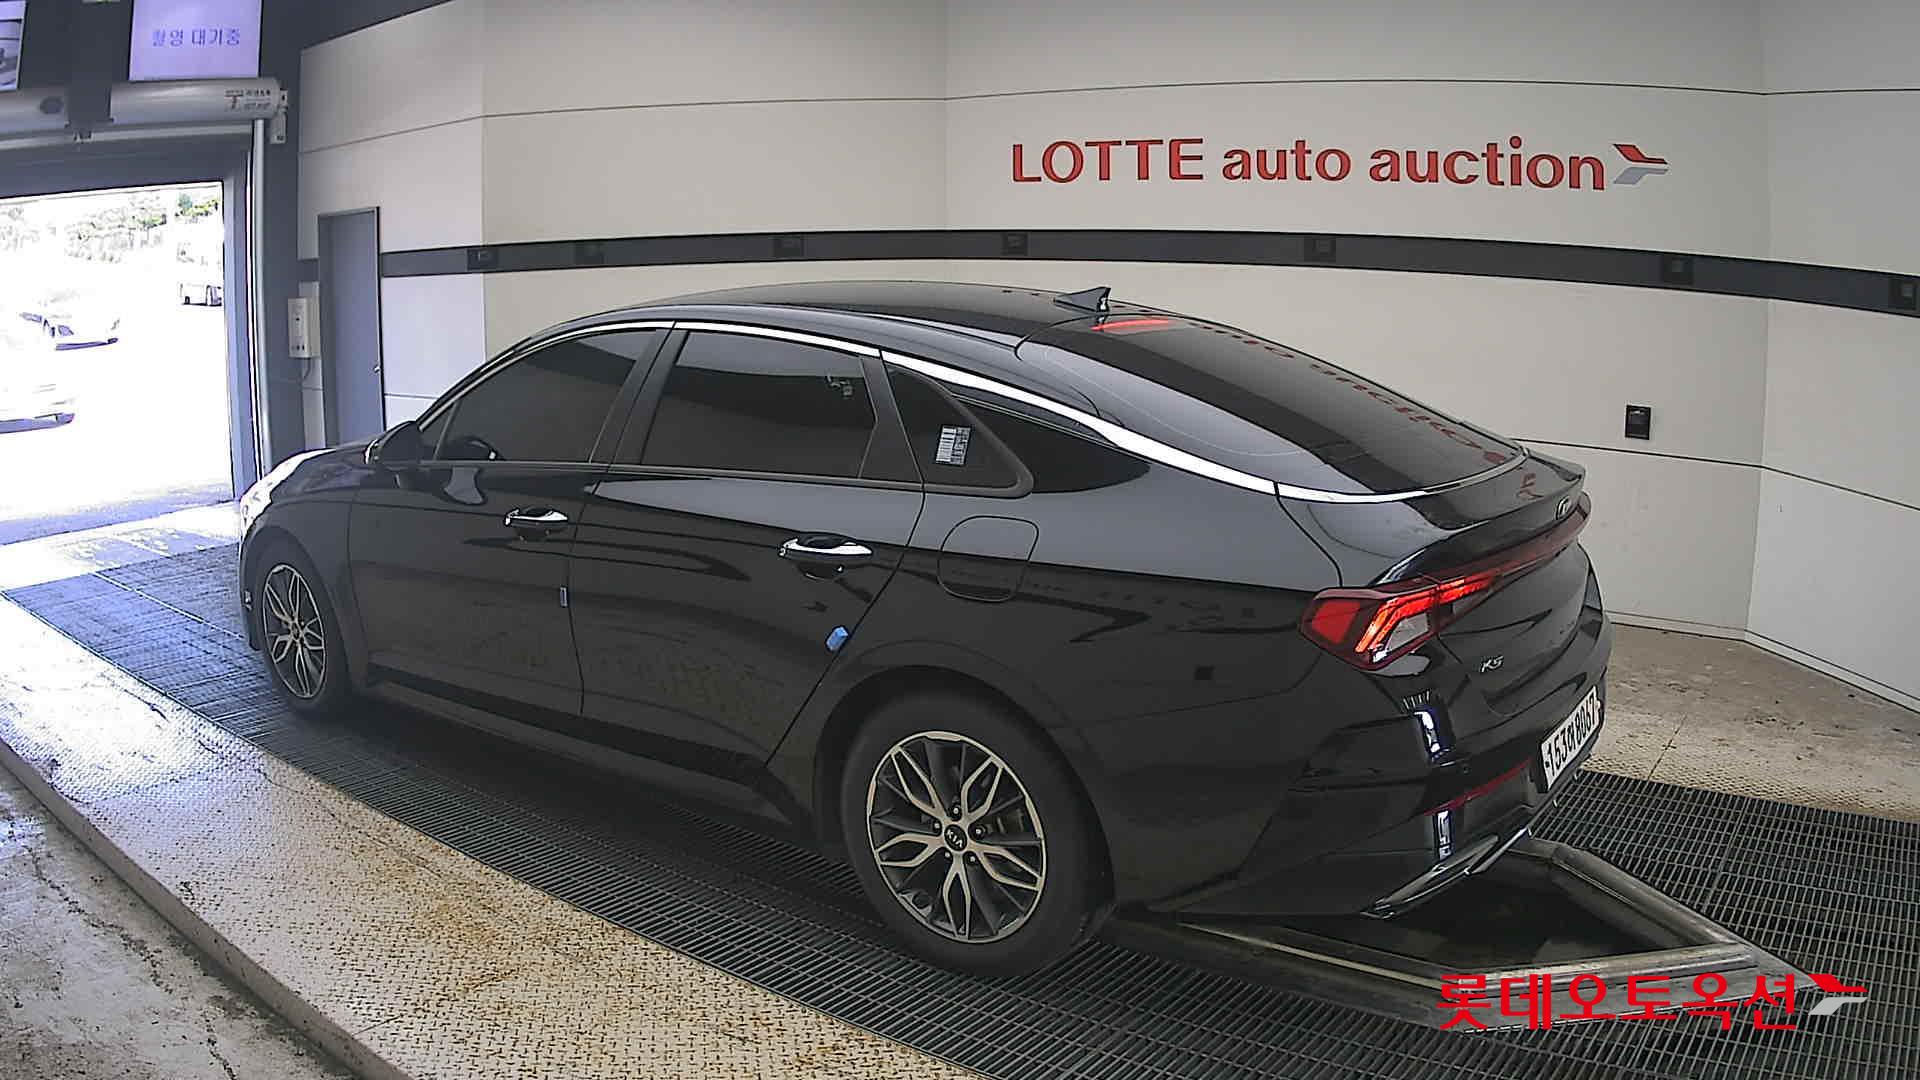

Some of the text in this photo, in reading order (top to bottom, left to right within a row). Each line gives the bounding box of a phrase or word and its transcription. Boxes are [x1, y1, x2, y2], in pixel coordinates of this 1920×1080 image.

[1012, 136, 1605, 191] LOTTE auto auction
